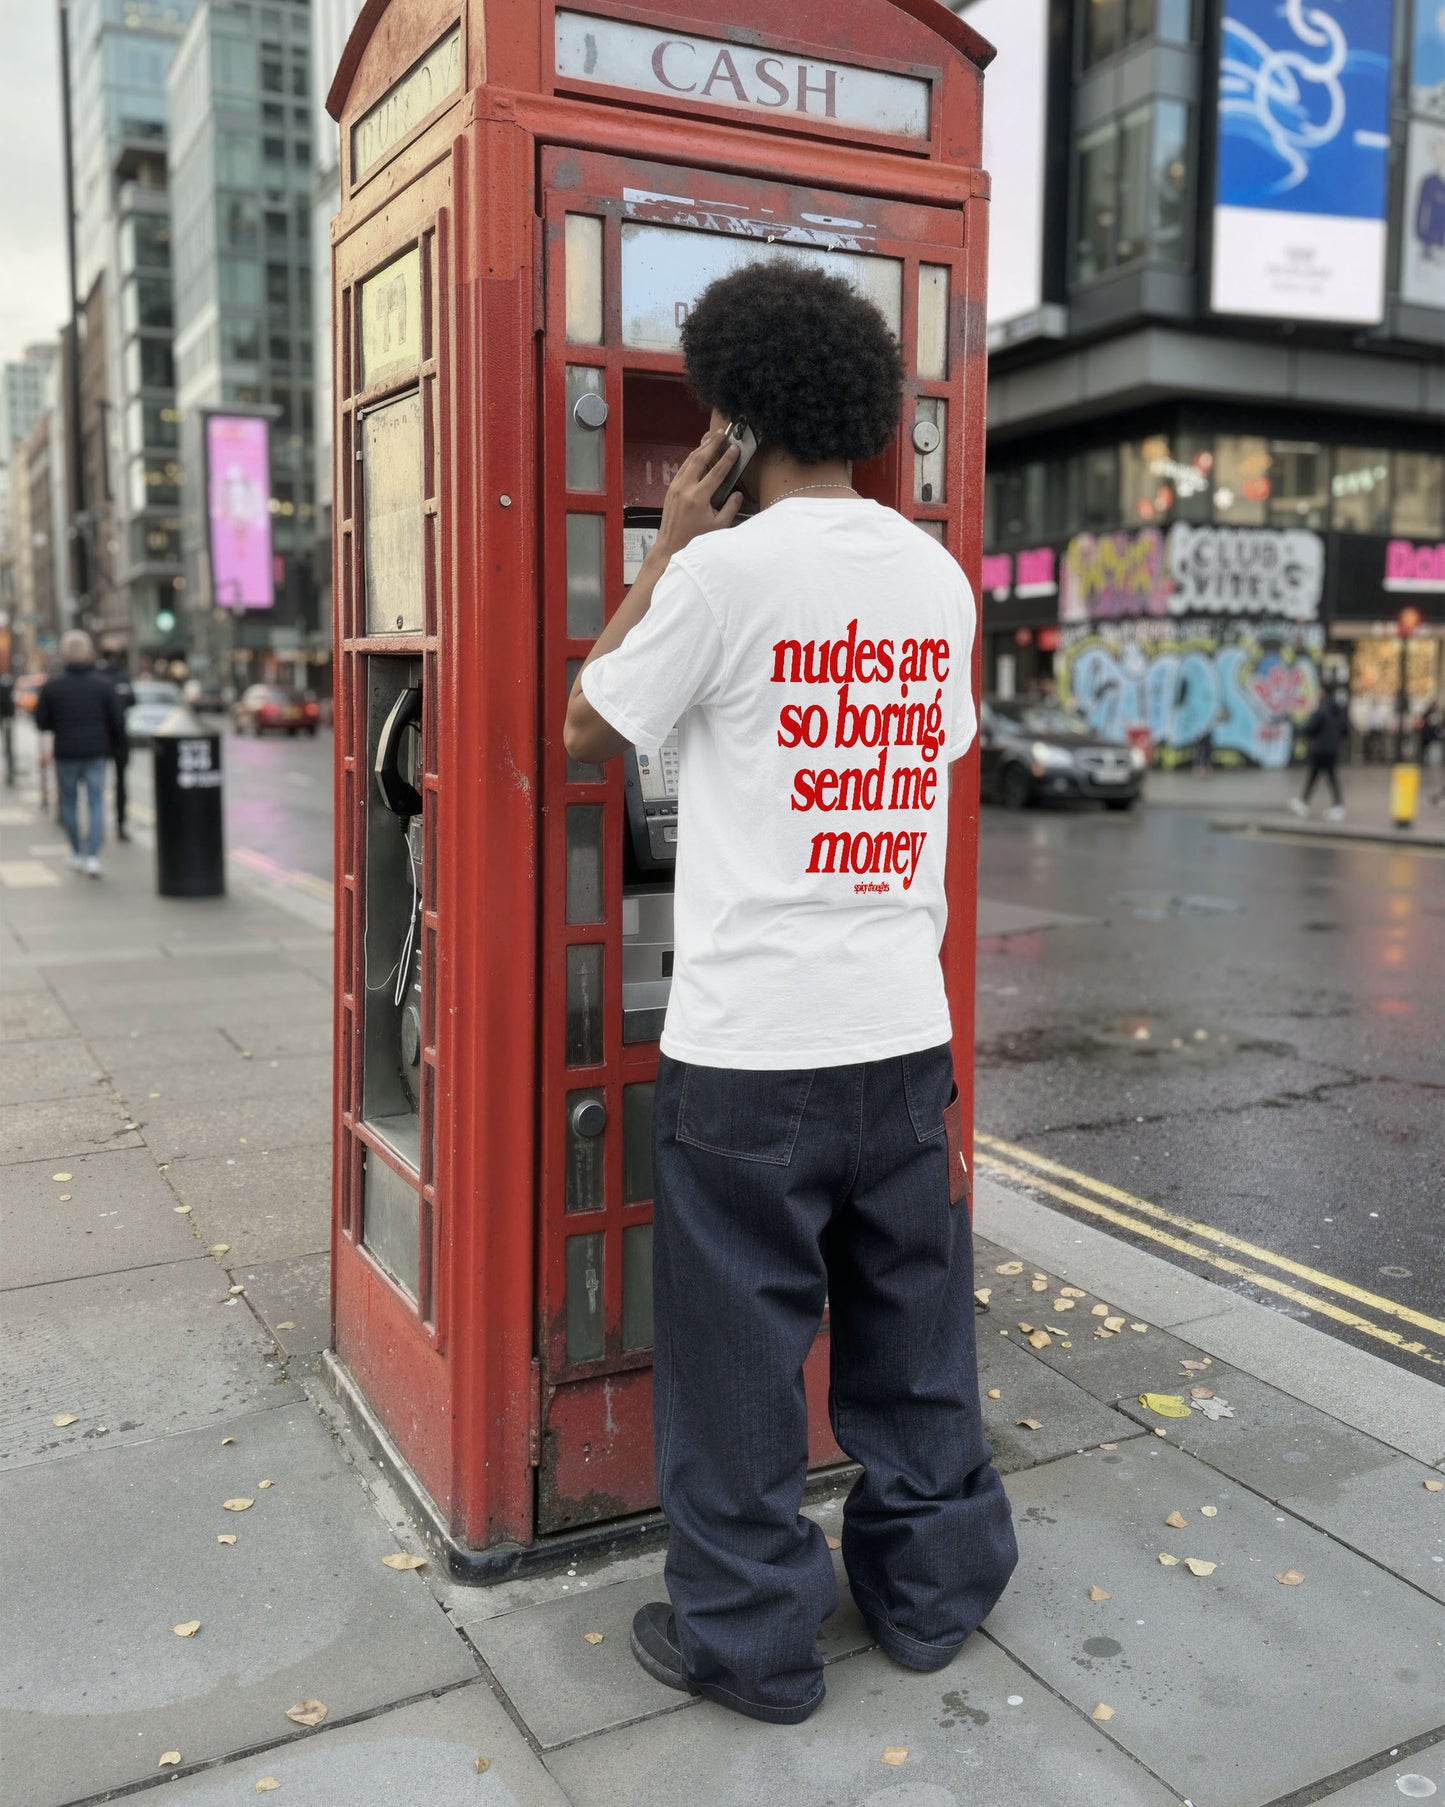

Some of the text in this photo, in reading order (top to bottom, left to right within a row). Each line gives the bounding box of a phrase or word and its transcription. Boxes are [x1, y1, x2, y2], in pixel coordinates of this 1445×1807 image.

[651, 39, 838, 118] CASH
[770, 618, 949, 684] nudes are
[777, 683, 946, 763] so boring.
[790, 747, 937, 812] send me
[805, 831, 928, 891] money
[868, 881, 891, 895] thoughts
